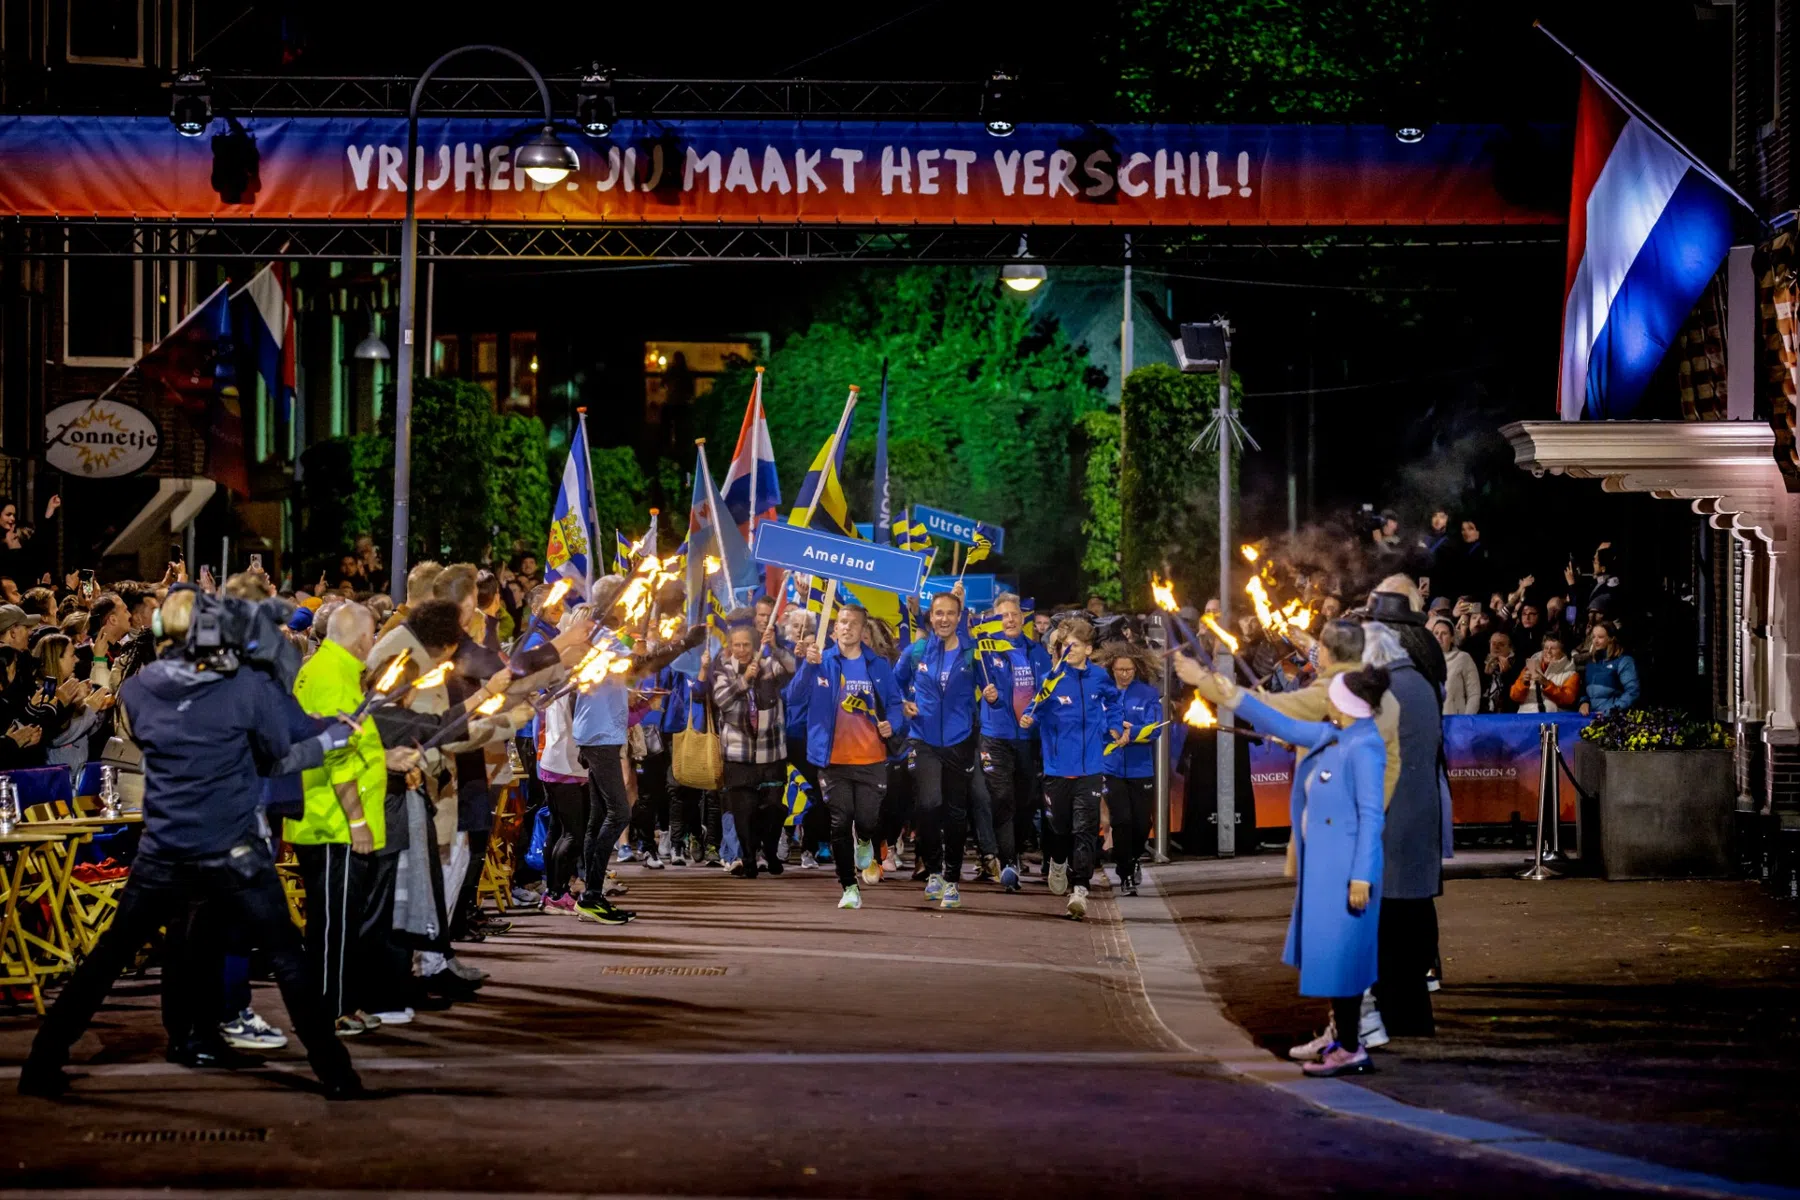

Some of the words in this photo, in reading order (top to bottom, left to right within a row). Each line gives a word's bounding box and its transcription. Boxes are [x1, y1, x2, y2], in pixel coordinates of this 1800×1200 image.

[346, 143, 580, 192] VRIJHEI.
[597, 144, 664, 192] JIJ
[683, 145, 863, 195] MAAKT
[881, 145, 977, 195] HET
[993, 148, 1252, 200] VERSCHIL!
[803, 545, 875, 572] Ameland
[1251, 772, 1289, 783] NINGEN
[1506, 767, 1516, 777] 45
